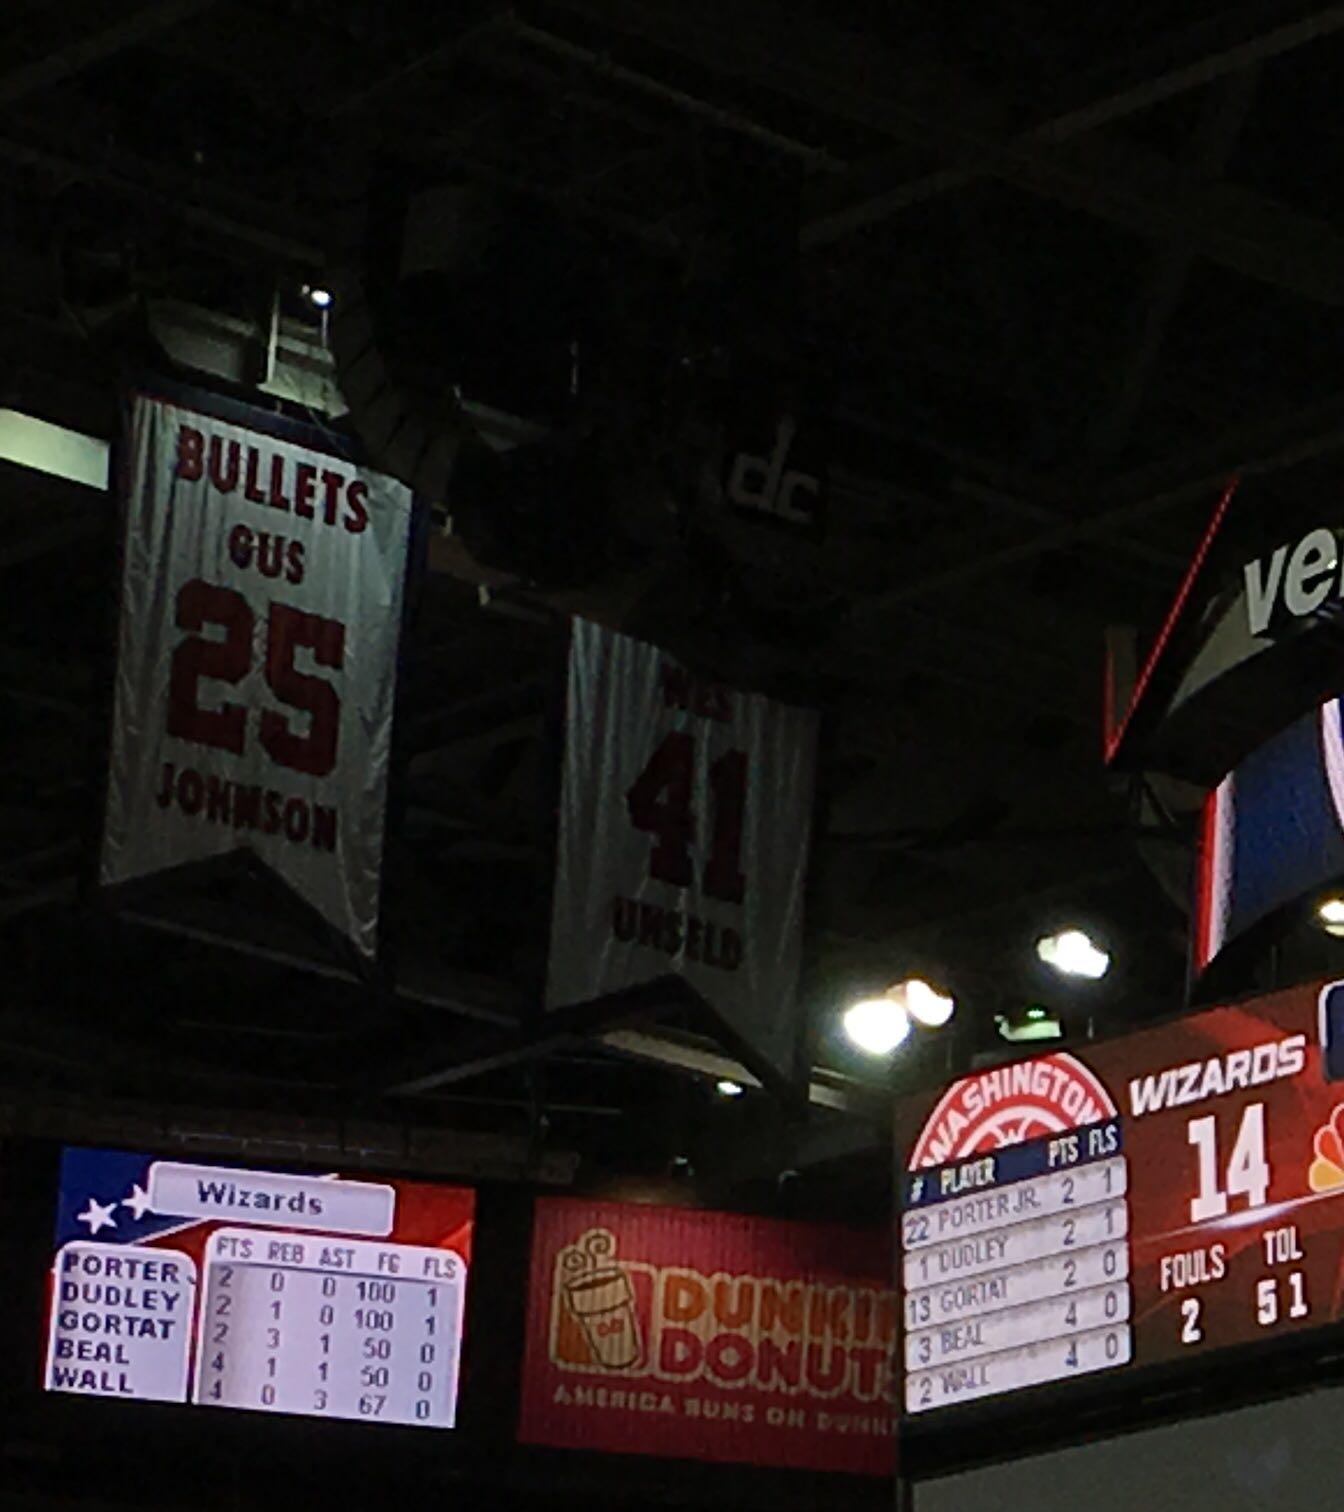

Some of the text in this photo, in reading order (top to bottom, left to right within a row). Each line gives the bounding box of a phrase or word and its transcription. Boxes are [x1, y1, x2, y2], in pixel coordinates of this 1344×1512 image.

[176, 424, 369, 533] BULLETS
[229, 524, 304, 584] GUS
[166, 578, 345, 777] 25
[156, 762, 336, 853] JOHNSON
[627, 731, 746, 904] 41
[1130, 1034, 1306, 1117] WIZARDS
[921, 1062, 1102, 1167] WASHINGTON
[1048, 1136, 1078, 1167] PTS
[1089, 1125, 1118, 1155] FLS
[1188, 1103, 1269, 1222] 14
[198, 1180, 324, 1215] Wizards
[905, 1214, 929, 1244] 22
[938, 1193, 1009, 1231] PORTER
[63, 1253, 179, 1284] PORTER
[355, 1281, 396, 1304] 100
[268, 1242, 305, 1264] REB
[319, 1248, 356, 1270] AST
[378, 1252, 400, 1273] FG
[425, 1255, 457, 1279] FLS
[939, 1235, 1009, 1272] DUDLEY
[1161, 1225, 1303, 1292] FOULS TOL
[62, 1281, 394, 1331] DUDLEY 100
[910, 1296, 931, 1324] 13
[1181, 1300, 1200, 1344] 2
[59, 1310, 390, 1360] GORTAT 50
[919, 1323, 985, 1363] 3 BEAL
[57, 1339, 389, 1388] BEAL 50
[53, 1367, 386, 1416] WALL 67
[554, 1384, 675, 1414] AMERICA
[685, 1399, 754, 1422] RUNS
[767, 1406, 805, 1428] ON
[920, 1377, 932, 1404] 2
